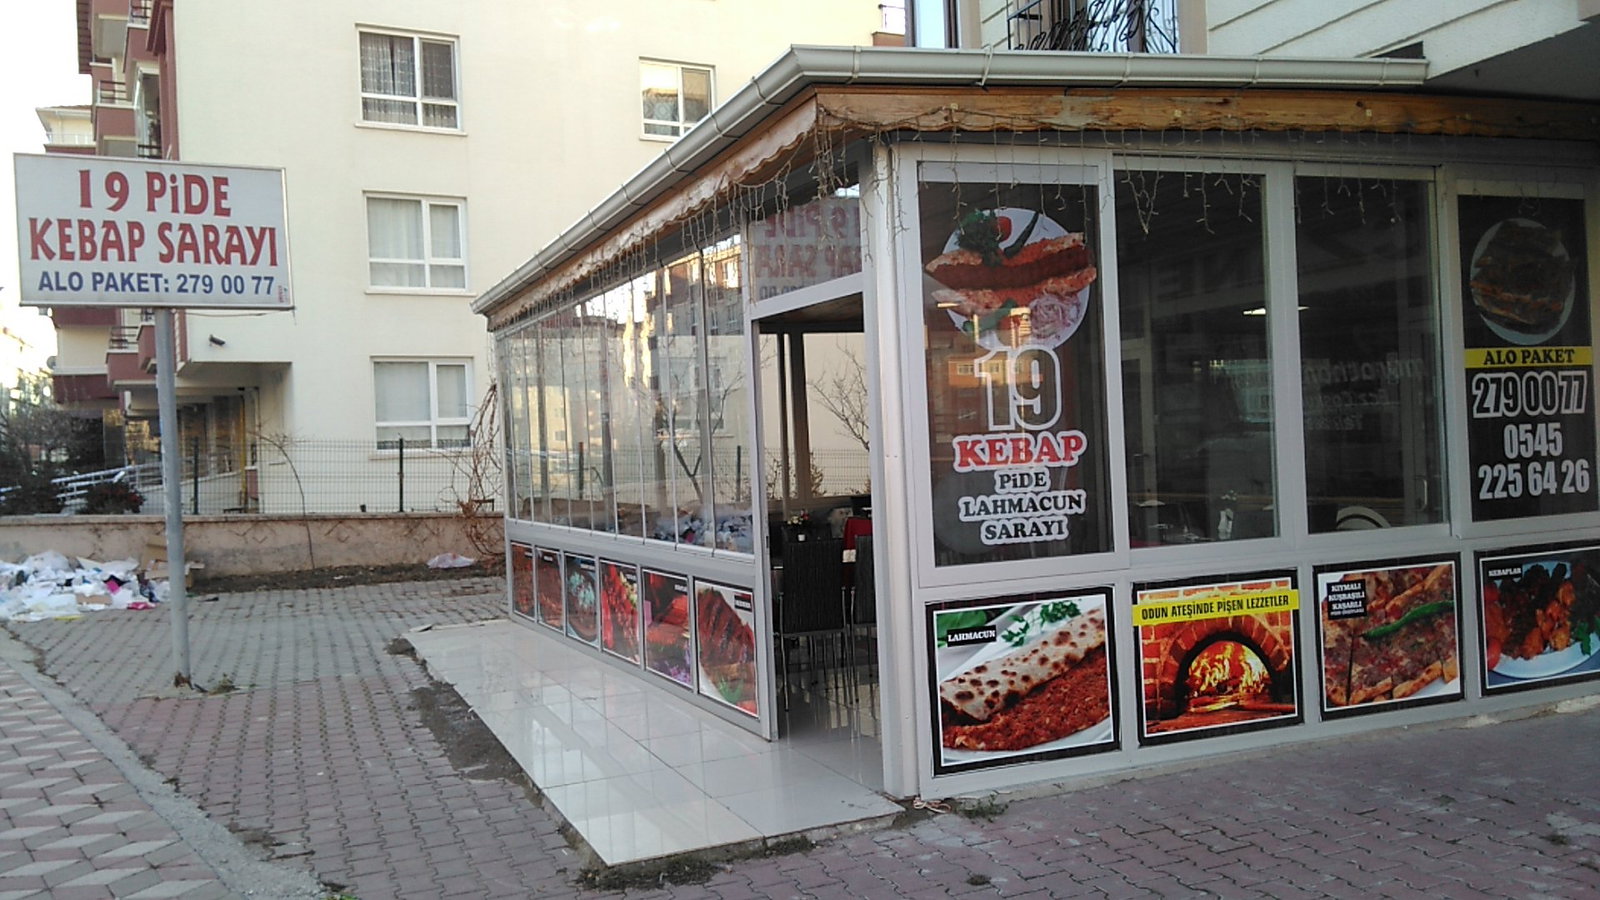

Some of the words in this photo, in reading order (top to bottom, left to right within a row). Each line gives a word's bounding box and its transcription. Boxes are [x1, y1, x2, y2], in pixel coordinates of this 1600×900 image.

[28, 217, 145, 262] KEBAP
[157, 222, 278, 267] SARAYI
[38, 271, 83, 292] ALO
[92, 272, 169, 293] PAKET:
[176, 274, 213, 294] 279
[221, 275, 245, 294] 00
[250, 276, 275, 295] 77
[1484, 350, 1517, 365] ALO
[1521, 349, 1575, 364] PAKET
[974, 345, 1062, 431] 19
[955, 433, 1084, 468] KEBAP
[1504, 423, 1563, 459] 0545
[1478, 463, 1523, 499] 225
[1527, 461, 1557, 496] 64
[1561, 459, 1590, 493] 26
[963, 494, 1083, 517] LAHMACUN
[984, 520, 1065, 540] SARAYI
[1141, 607, 1168, 620] ODUN
[1171, 601, 1214, 618] ATEŞİNDE
[1217, 598, 1244, 614] PİŞEN
[1246, 594, 1289, 610] LEZZETLER
[947, 630, 996, 642] LAHMACUN
